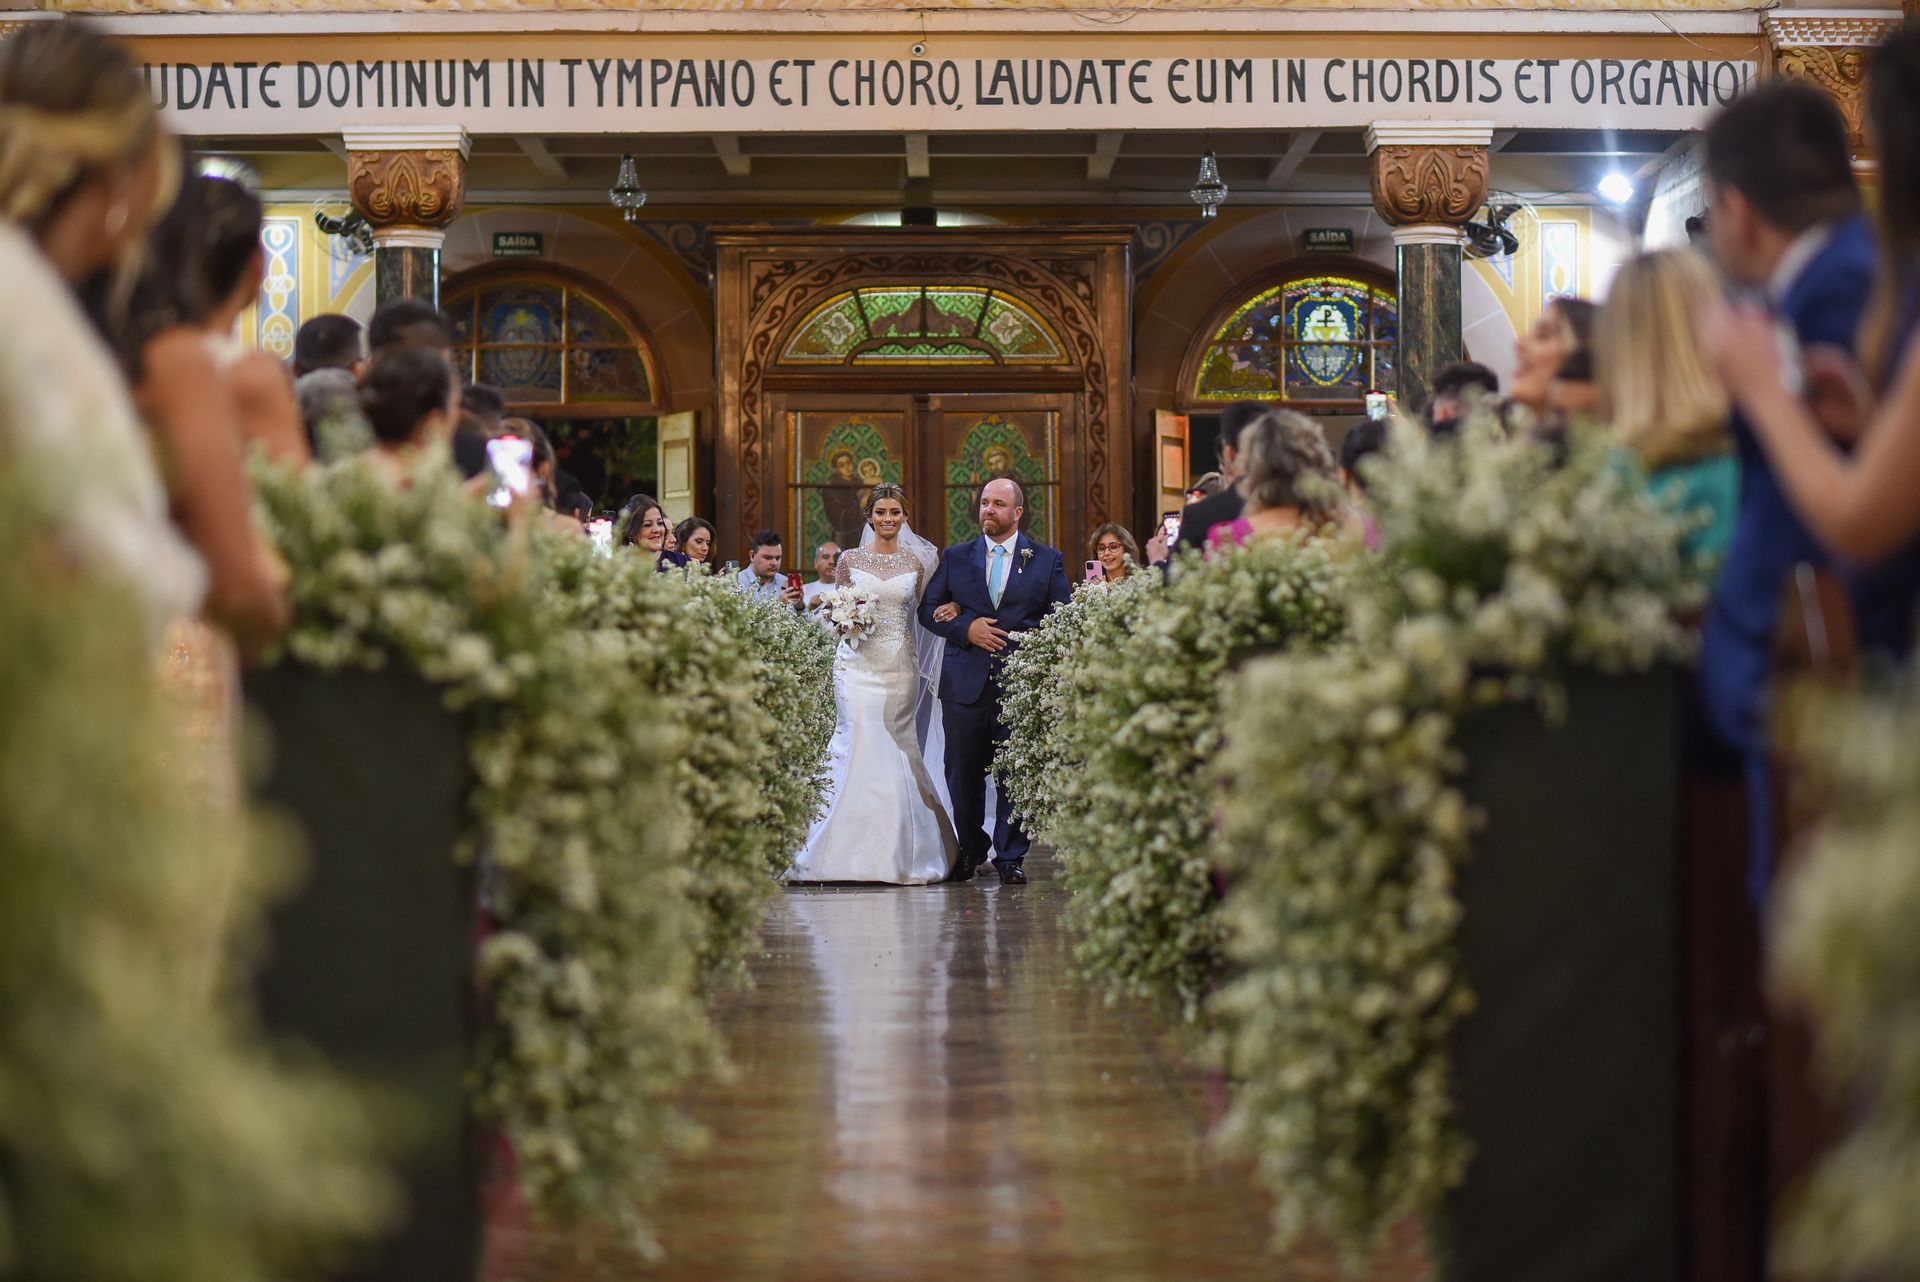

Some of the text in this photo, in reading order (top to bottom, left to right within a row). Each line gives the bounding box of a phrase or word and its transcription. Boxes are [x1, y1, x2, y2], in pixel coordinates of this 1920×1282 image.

[143, 61, 283, 110] UDATE
[297, 59, 490, 107] DOMINUM
[507, 59, 545, 107] IN
[560, 58, 755, 107] TYMPANO
[769, 59, 816, 107] ET
[828, 60, 964, 111] CHORO,
[976, 59, 1153, 105] LAUDATE
[1167, 59, 1253, 104] EUM
[1272, 59, 1306, 103] IN
[1324, 59, 1502, 103] CHORDIS
[1514, 59, 1560, 104] ET
[1310, 230, 1347, 242] SAÍDA
